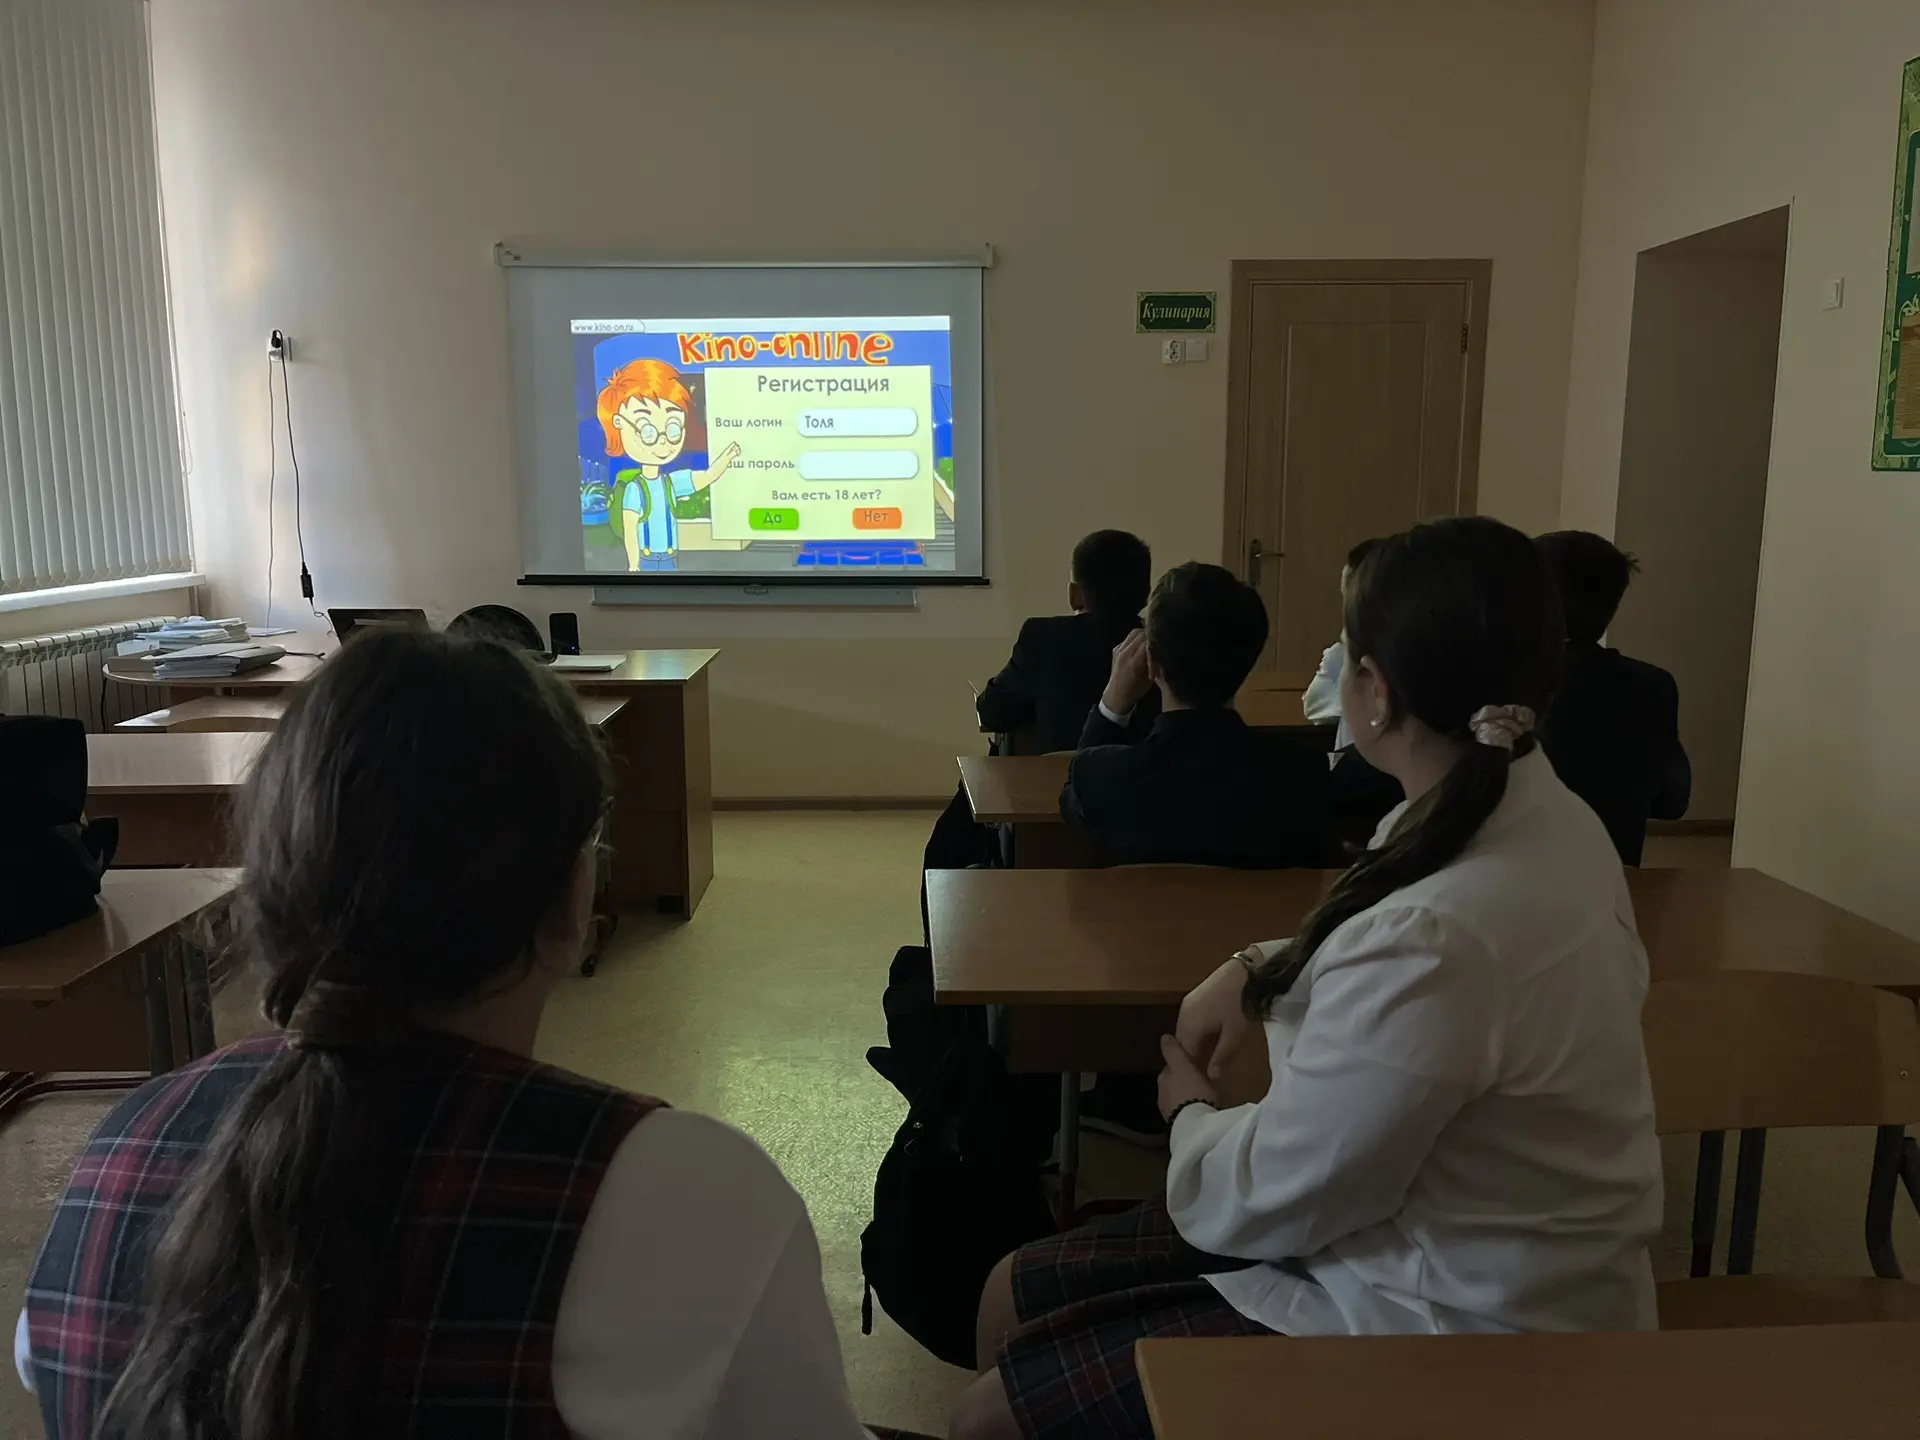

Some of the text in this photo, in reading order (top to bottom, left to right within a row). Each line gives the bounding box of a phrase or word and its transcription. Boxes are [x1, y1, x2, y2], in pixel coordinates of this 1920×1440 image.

[1142, 302, 1210, 322] Кулинария
[757, 375, 890, 396] Регистрация
[715, 417, 782, 428] Ваш логин
[804, 415, 834, 429] Толя
[727, 459, 795, 470] аш пароль
[771, 489, 882, 500] Вам есть 18 лет?
[763, 511, 782, 525] Да
[864, 510, 888, 523] Нет
